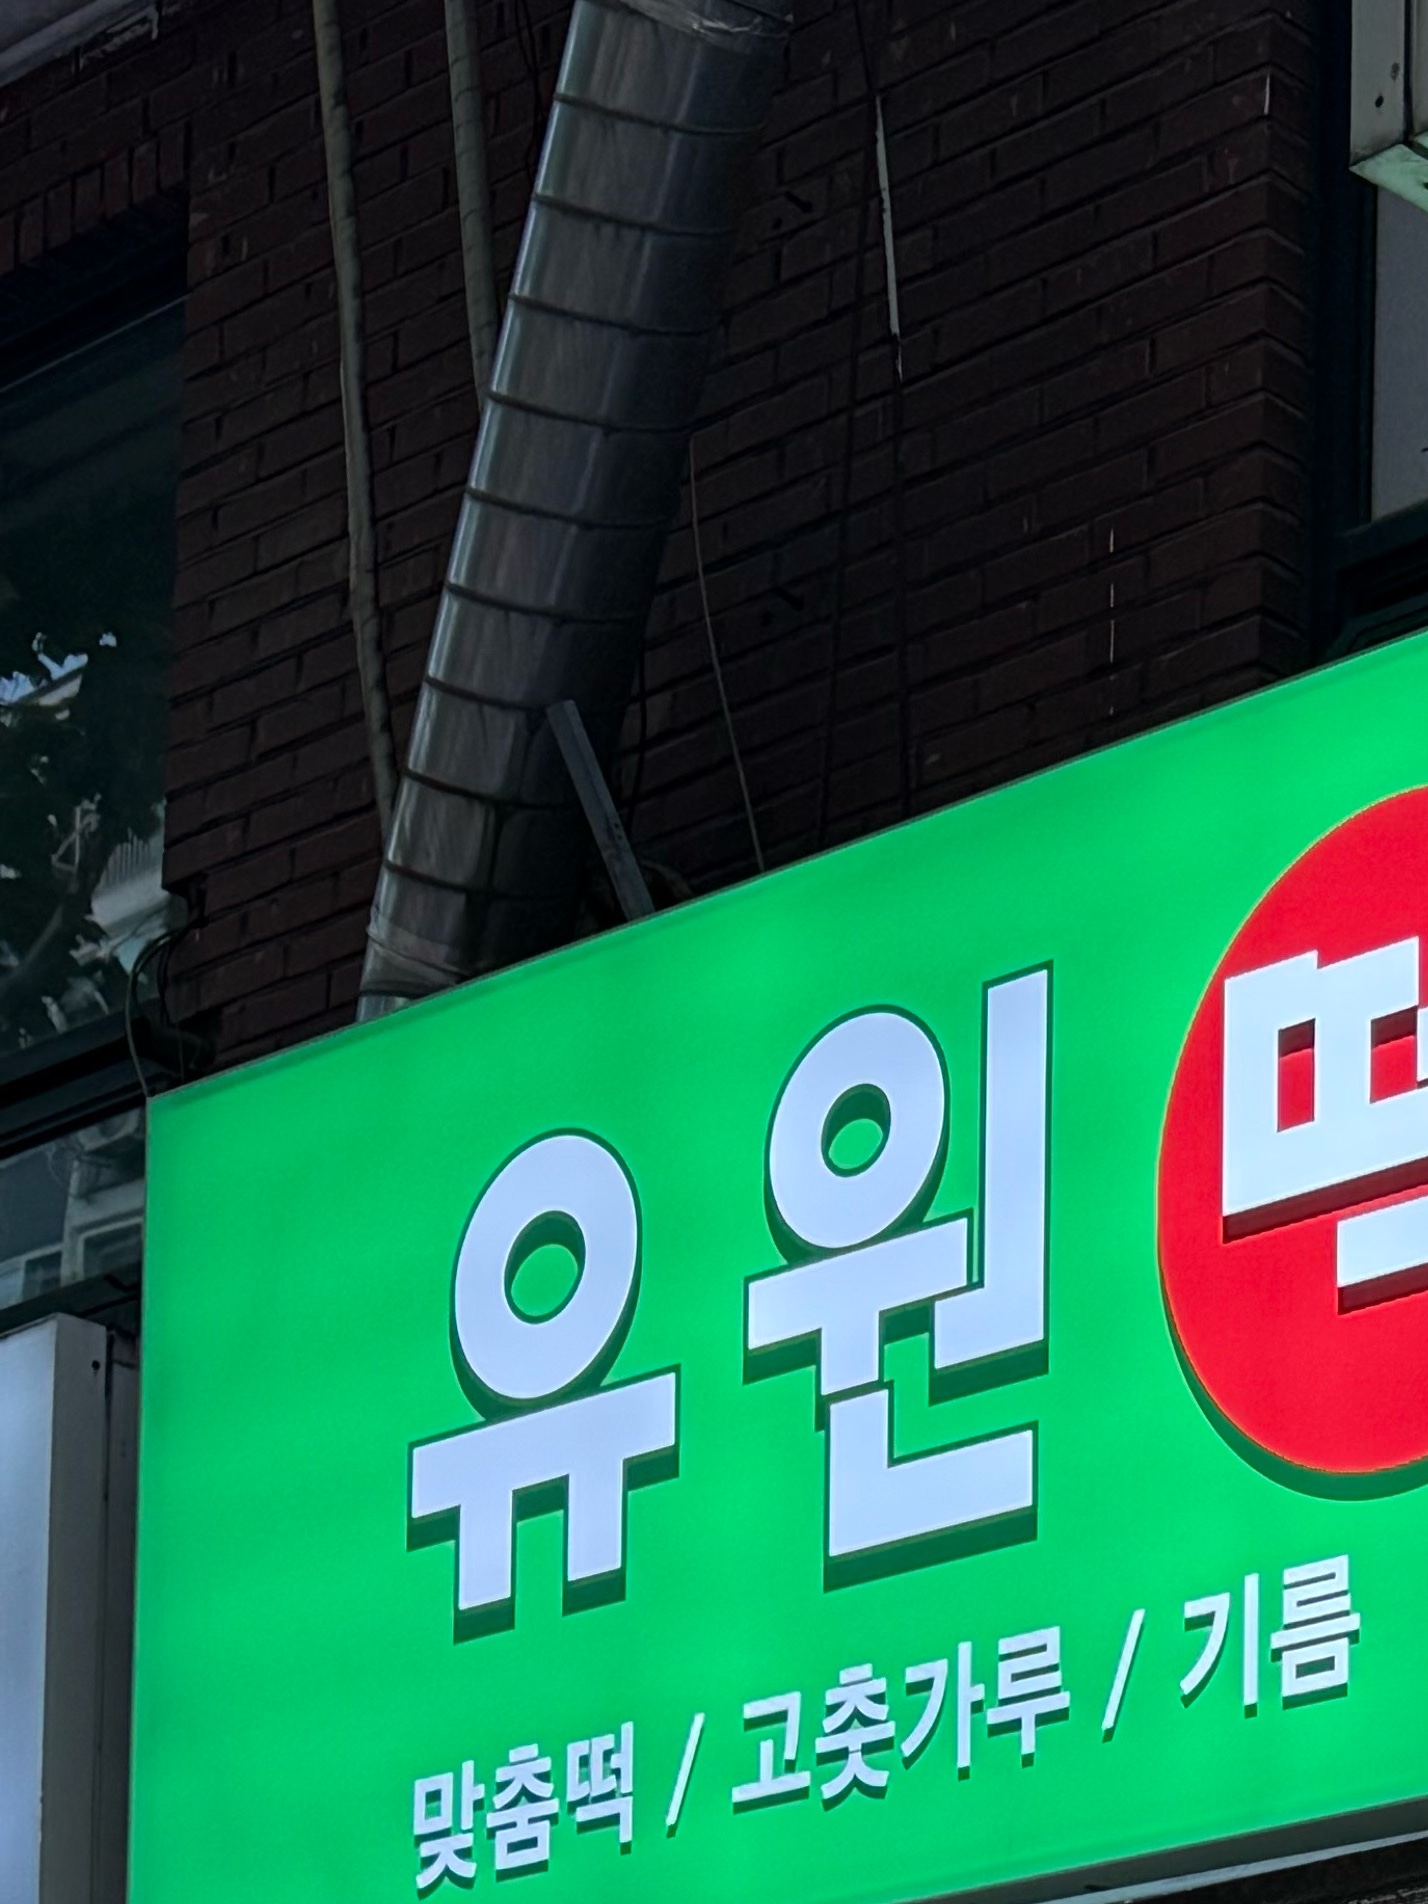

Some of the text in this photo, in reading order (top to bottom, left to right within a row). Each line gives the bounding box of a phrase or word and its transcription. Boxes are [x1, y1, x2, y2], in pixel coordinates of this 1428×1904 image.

[413, 1721, 634, 1900] 맞춤떡
[731, 1626, 1070, 1805] 고춧가루
[1180, 1555, 1360, 1716] 기름
